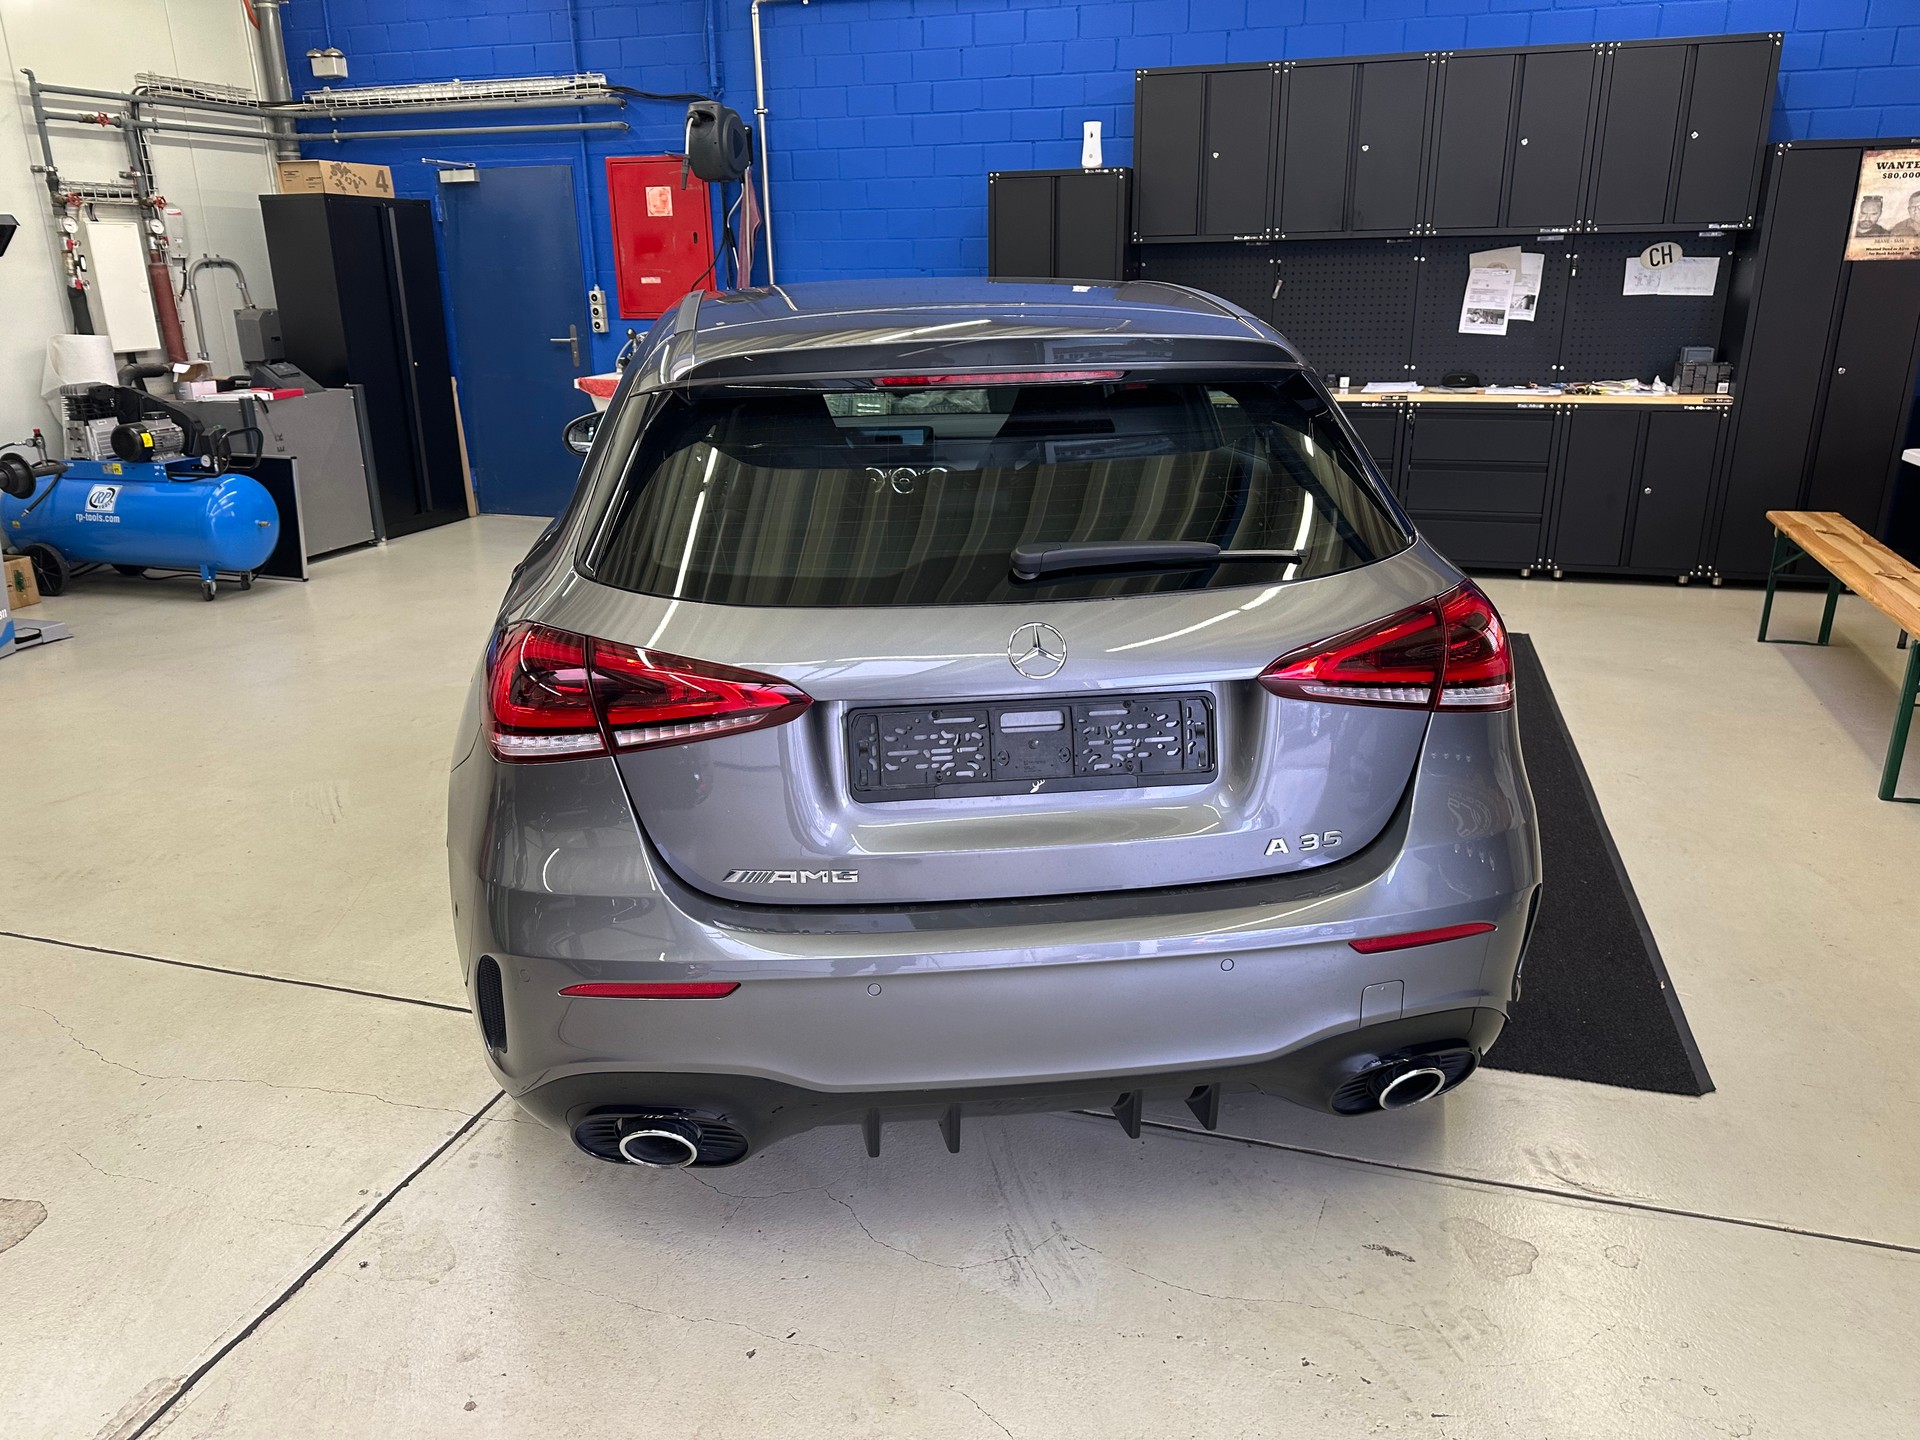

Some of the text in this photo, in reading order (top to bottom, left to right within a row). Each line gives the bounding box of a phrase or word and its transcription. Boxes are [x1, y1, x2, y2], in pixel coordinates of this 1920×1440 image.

[375, 169, 389, 193] 4
[1648, 244, 1673, 267] CH
[93, 491, 112, 504] RP
[75, 513, 120, 523] rp-tools.com
[1264, 829, 1343, 856] A 35
[768, 869, 859, 884] AMG
